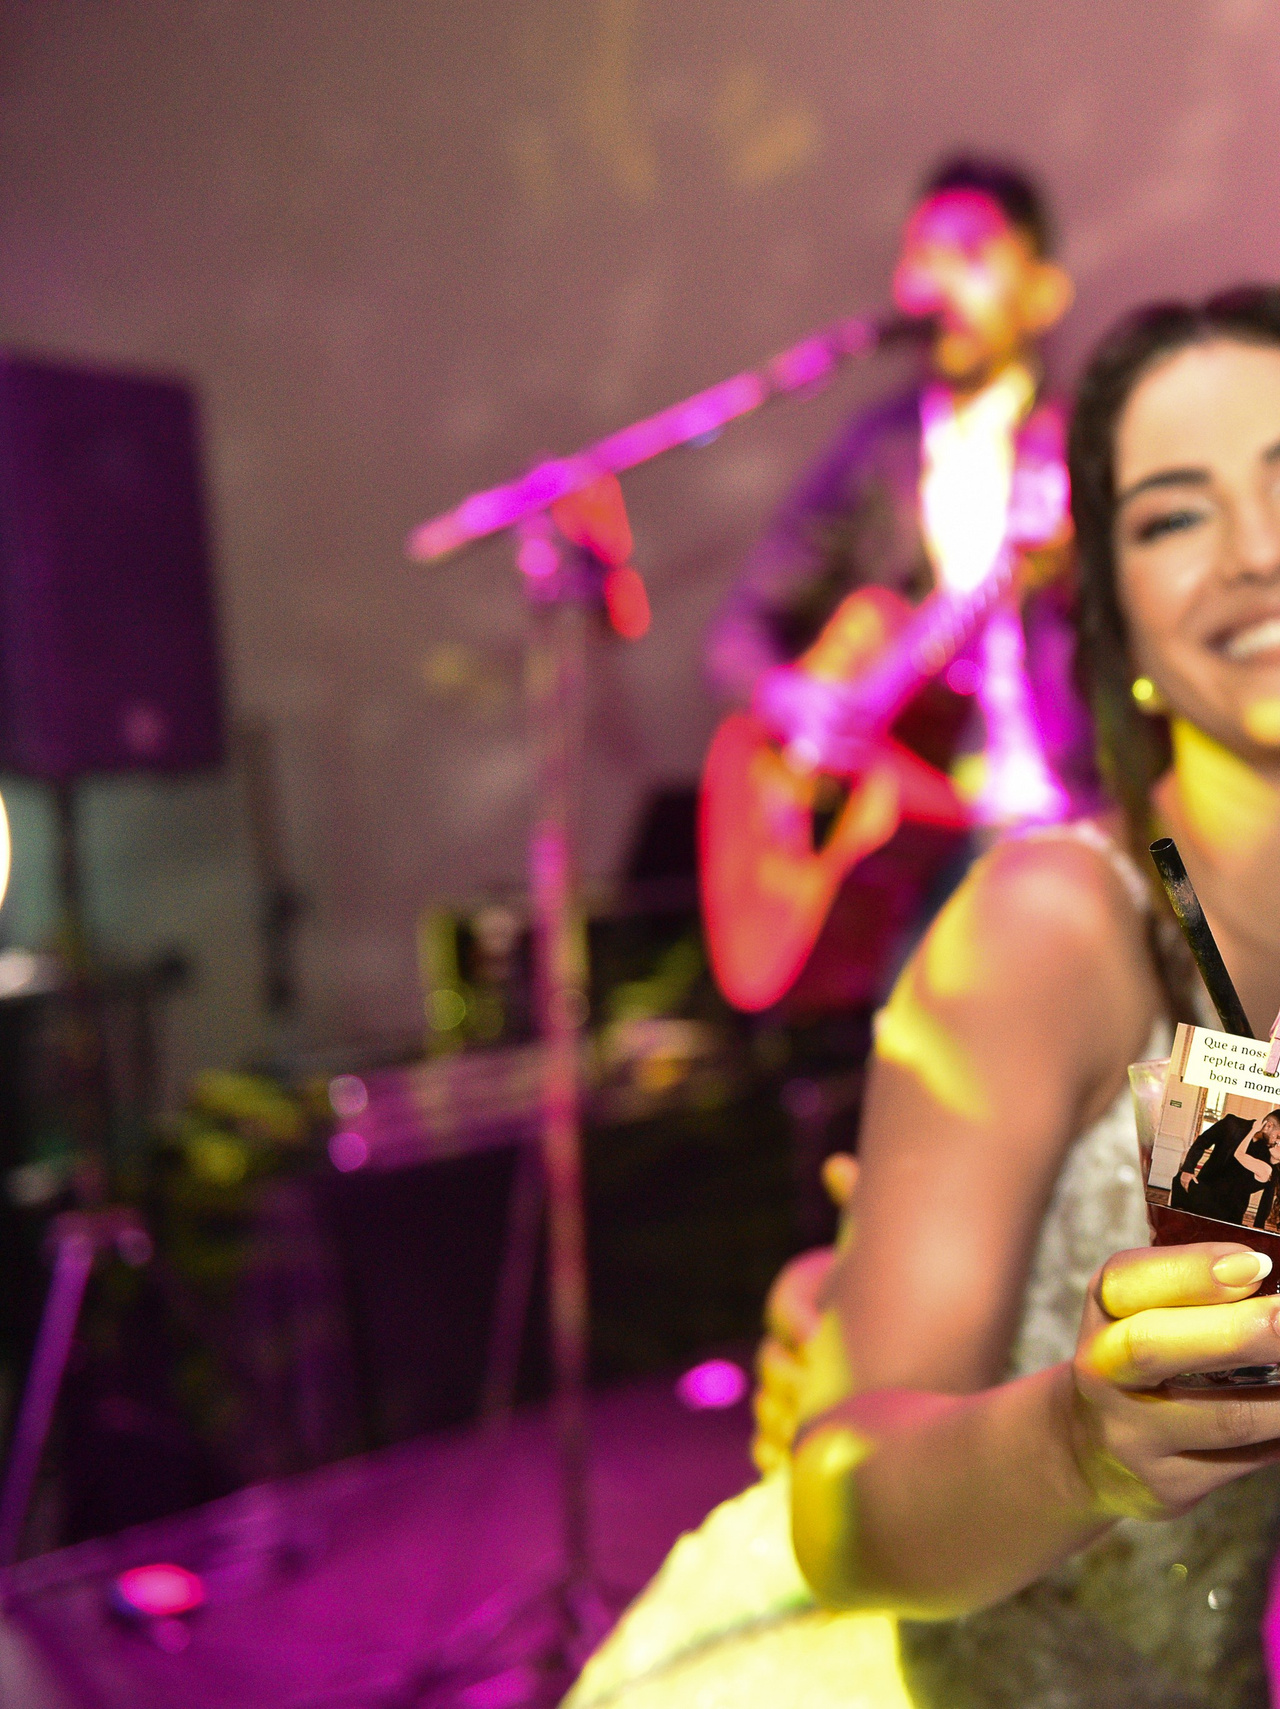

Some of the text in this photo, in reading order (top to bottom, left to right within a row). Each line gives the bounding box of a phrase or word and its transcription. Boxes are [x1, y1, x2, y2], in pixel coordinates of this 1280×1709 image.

[1204, 1036, 1228, 1050] Que
[1231, 1044, 1237, 1053] a
[1241, 1046, 1269, 1059] noss
[1203, 1054, 1245, 1071] repleta
[1248, 1063, 1263, 1075] de
[1209, 1069, 1238, 1086] bons
